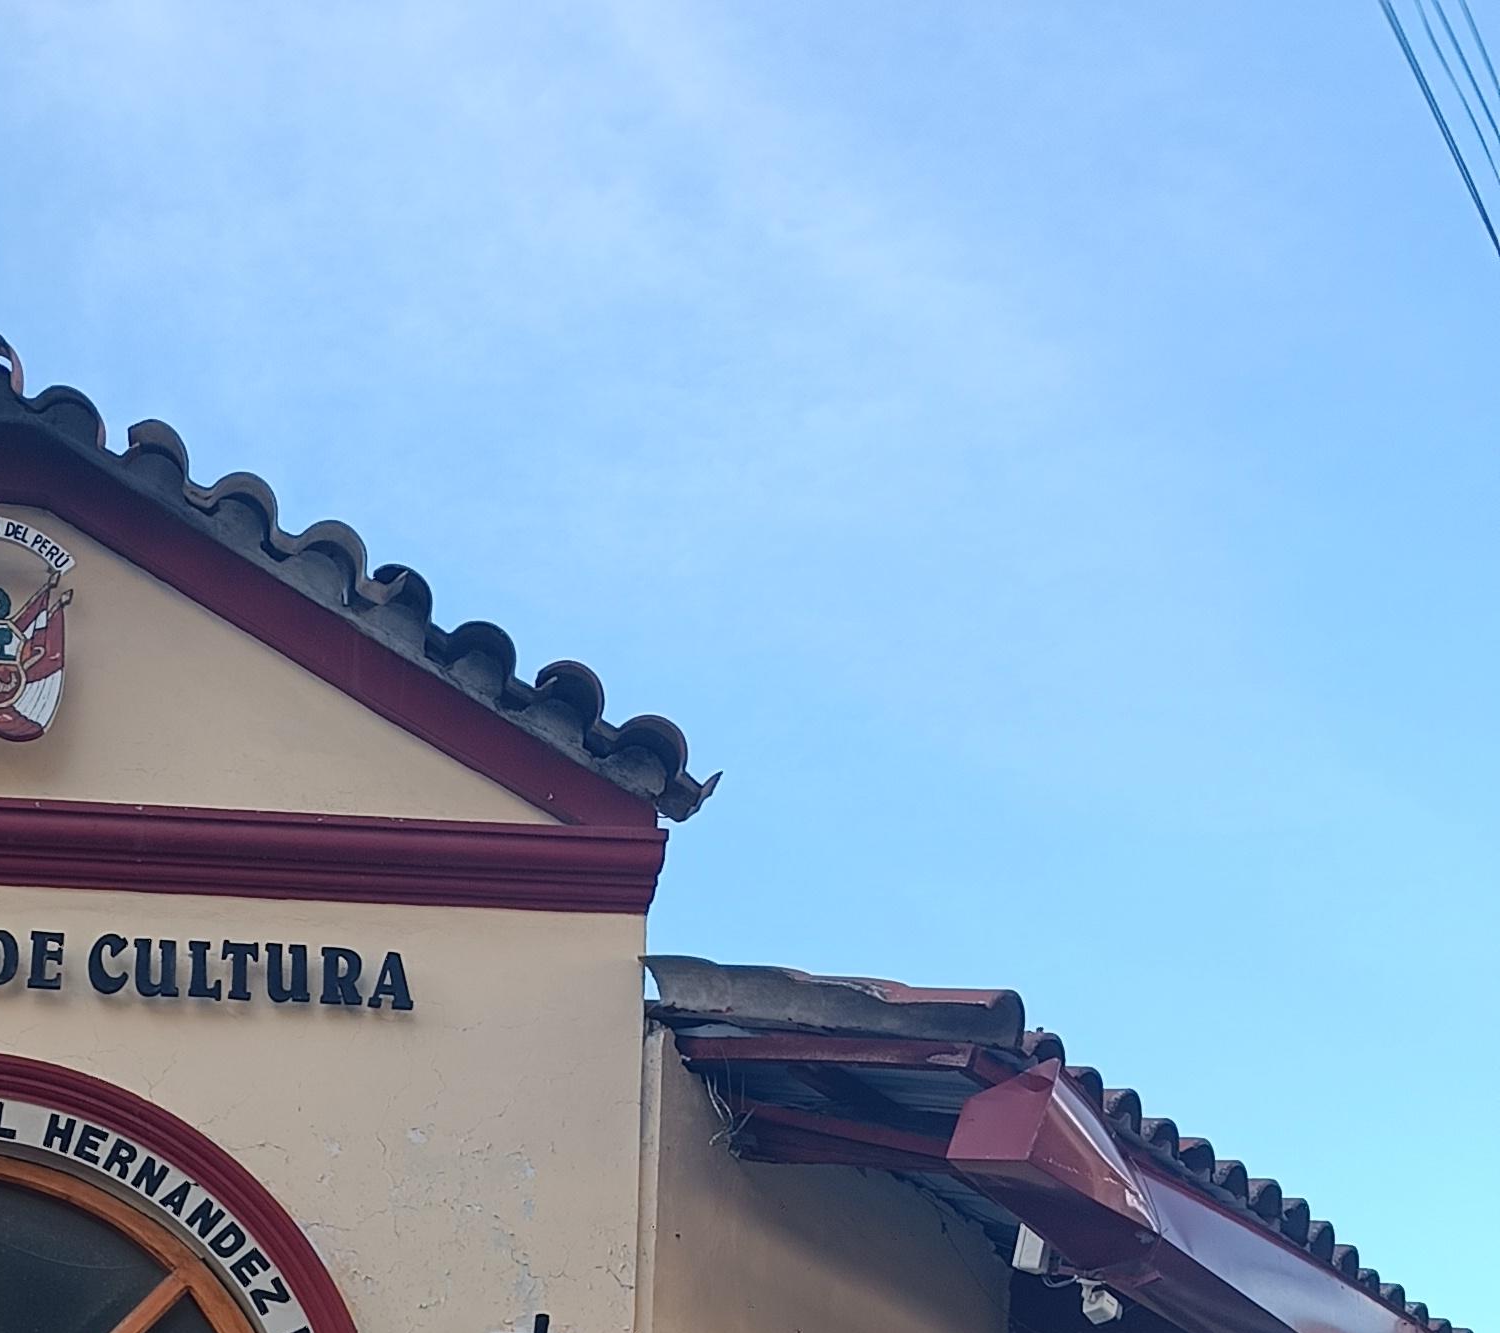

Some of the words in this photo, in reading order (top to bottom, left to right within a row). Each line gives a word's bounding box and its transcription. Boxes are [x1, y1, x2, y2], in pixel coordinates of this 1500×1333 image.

[4, 521, 29, 543] DEL
[30, 534, 70, 570] PERÚ
[87, 932, 415, 1010] CULTURA
[43, 1113, 292, 1315] HERNÁNDEZ
